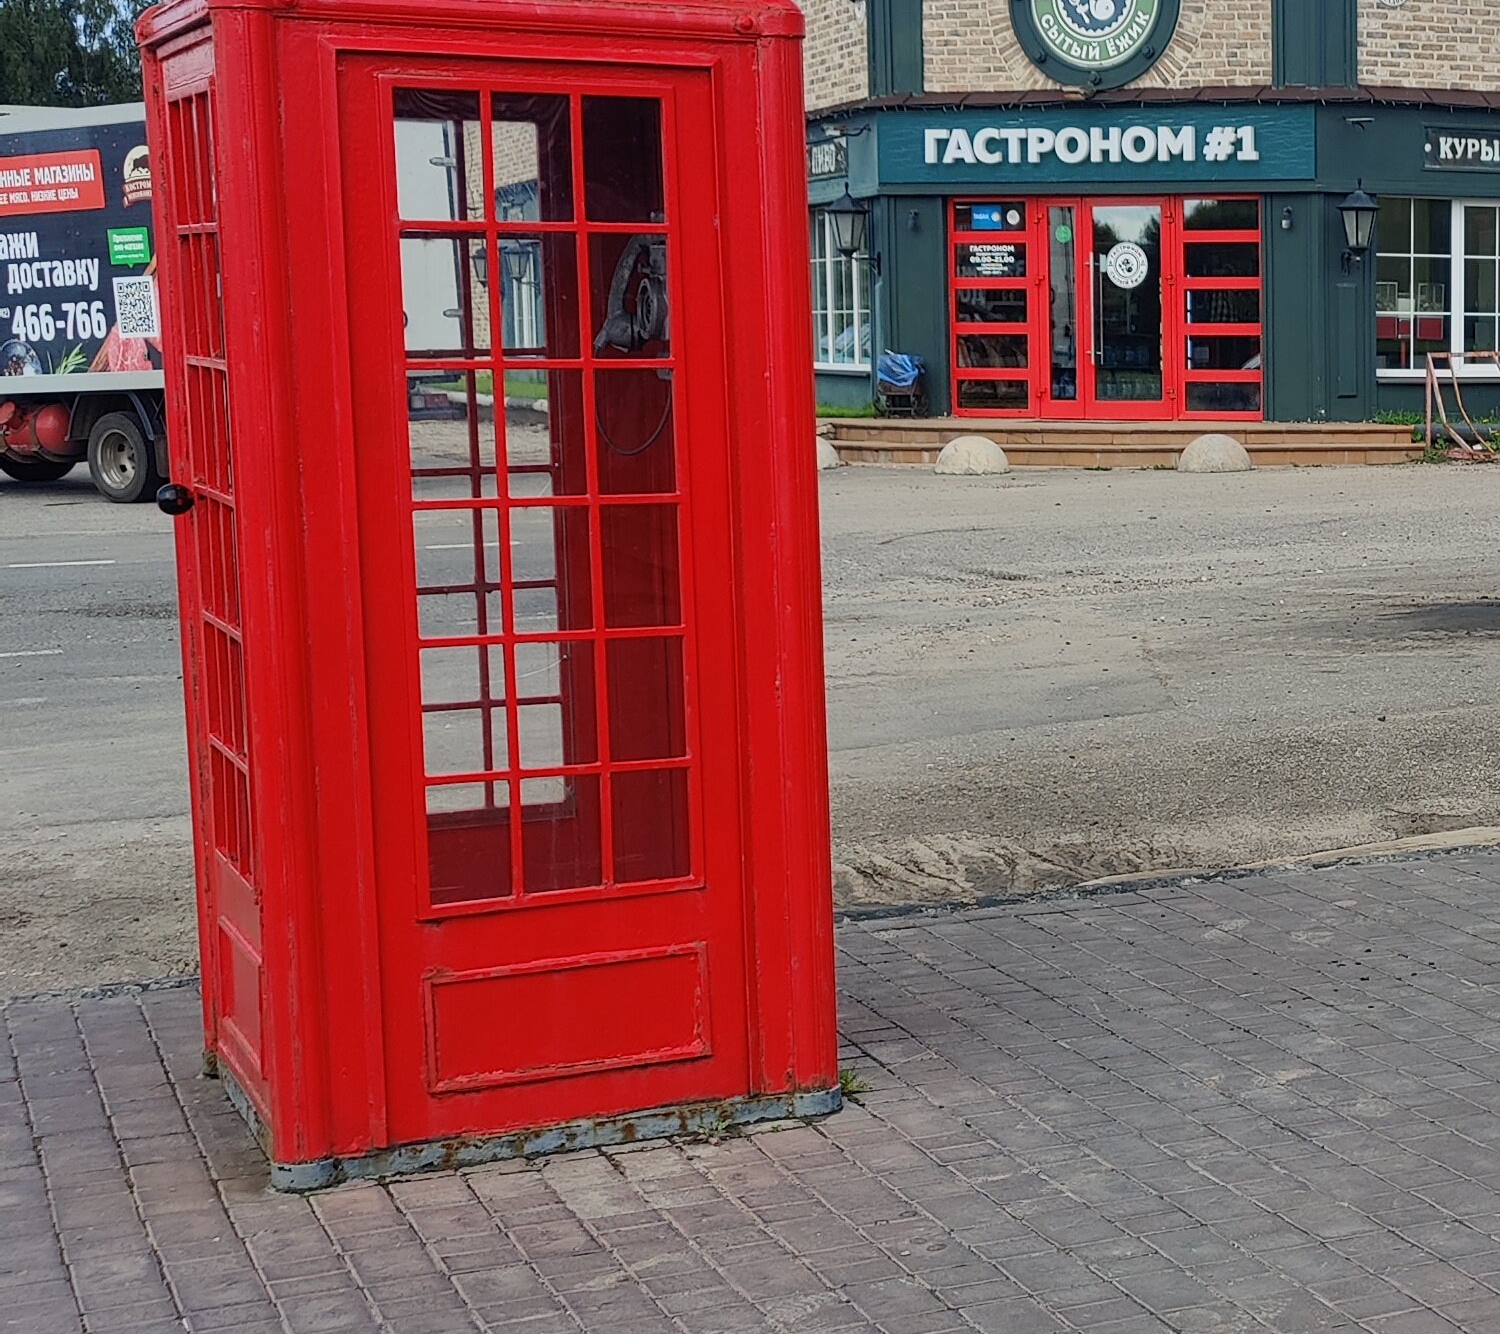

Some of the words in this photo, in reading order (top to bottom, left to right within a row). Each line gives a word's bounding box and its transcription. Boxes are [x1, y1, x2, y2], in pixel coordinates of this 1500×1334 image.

[1041, 14, 1100, 60] СЫТЫЙ
[1105, 10, 1150, 57] ЁЖИК
[924, 126, 1195, 164] ГАСТРОНОМ
[1203, 126, 1259, 162] #1
[34, 163, 95, 185] МАГАЗИНЫ
[58, 187, 79, 201] ЦЕНЫ
[8, 258, 99, 295] доставку
[12, 301, 107, 342] 466-766
